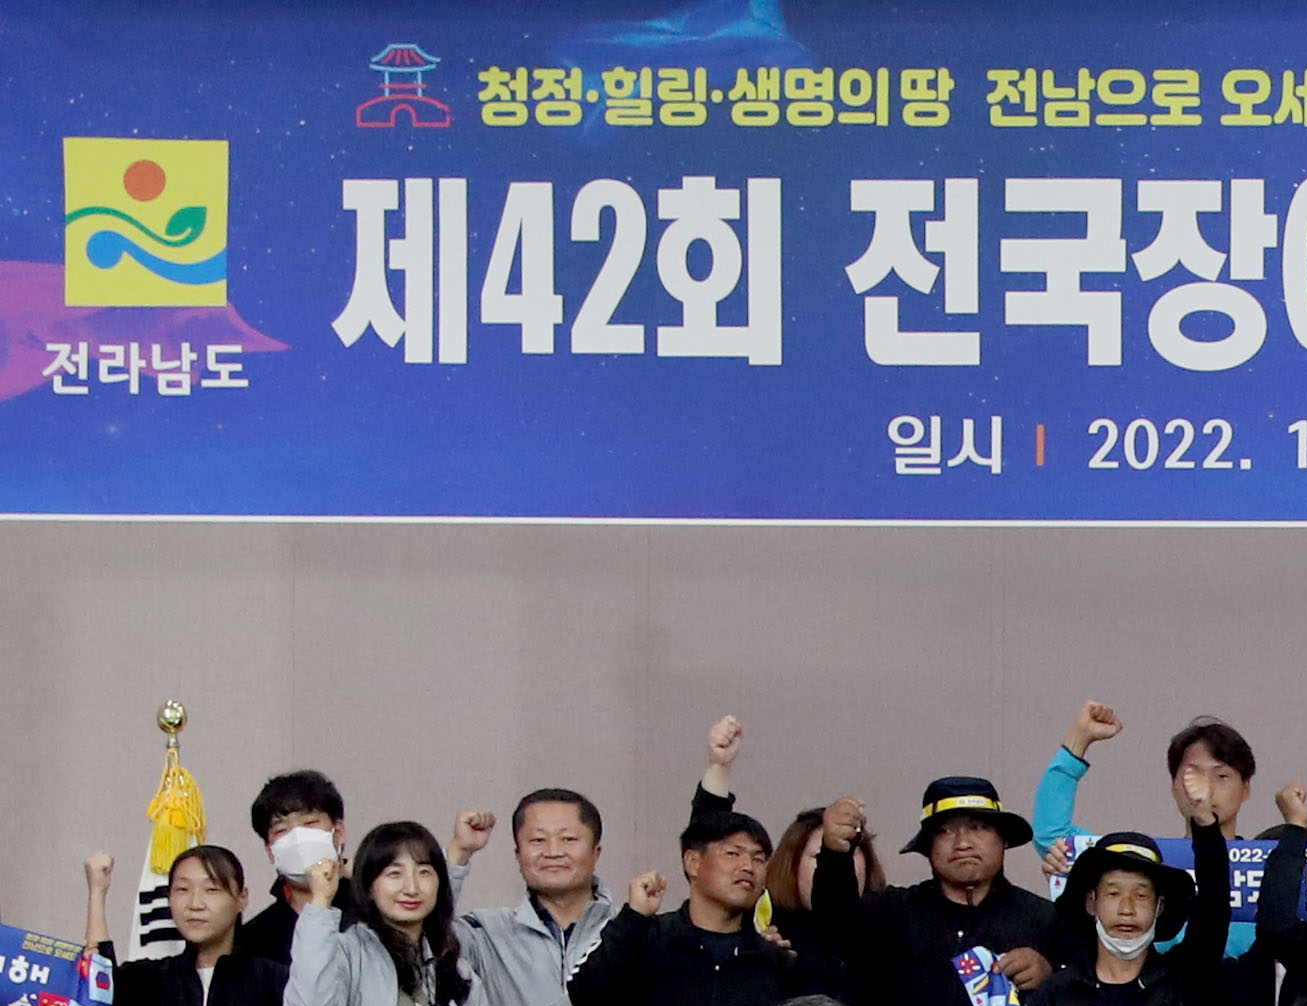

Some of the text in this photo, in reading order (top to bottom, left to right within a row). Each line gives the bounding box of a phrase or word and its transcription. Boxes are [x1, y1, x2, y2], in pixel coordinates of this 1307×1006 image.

[478, 66, 888, 126] 청정·힐링·생명의
[906, 68, 954, 126] 땅
[987, 68, 1202, 126] 전남으로
[332, 176, 781, 365] 제42회
[42, 340, 250, 394] 전라남도
[888, 416, 1001, 474] 일시
[1088, 419, 1251, 469] 2022.
